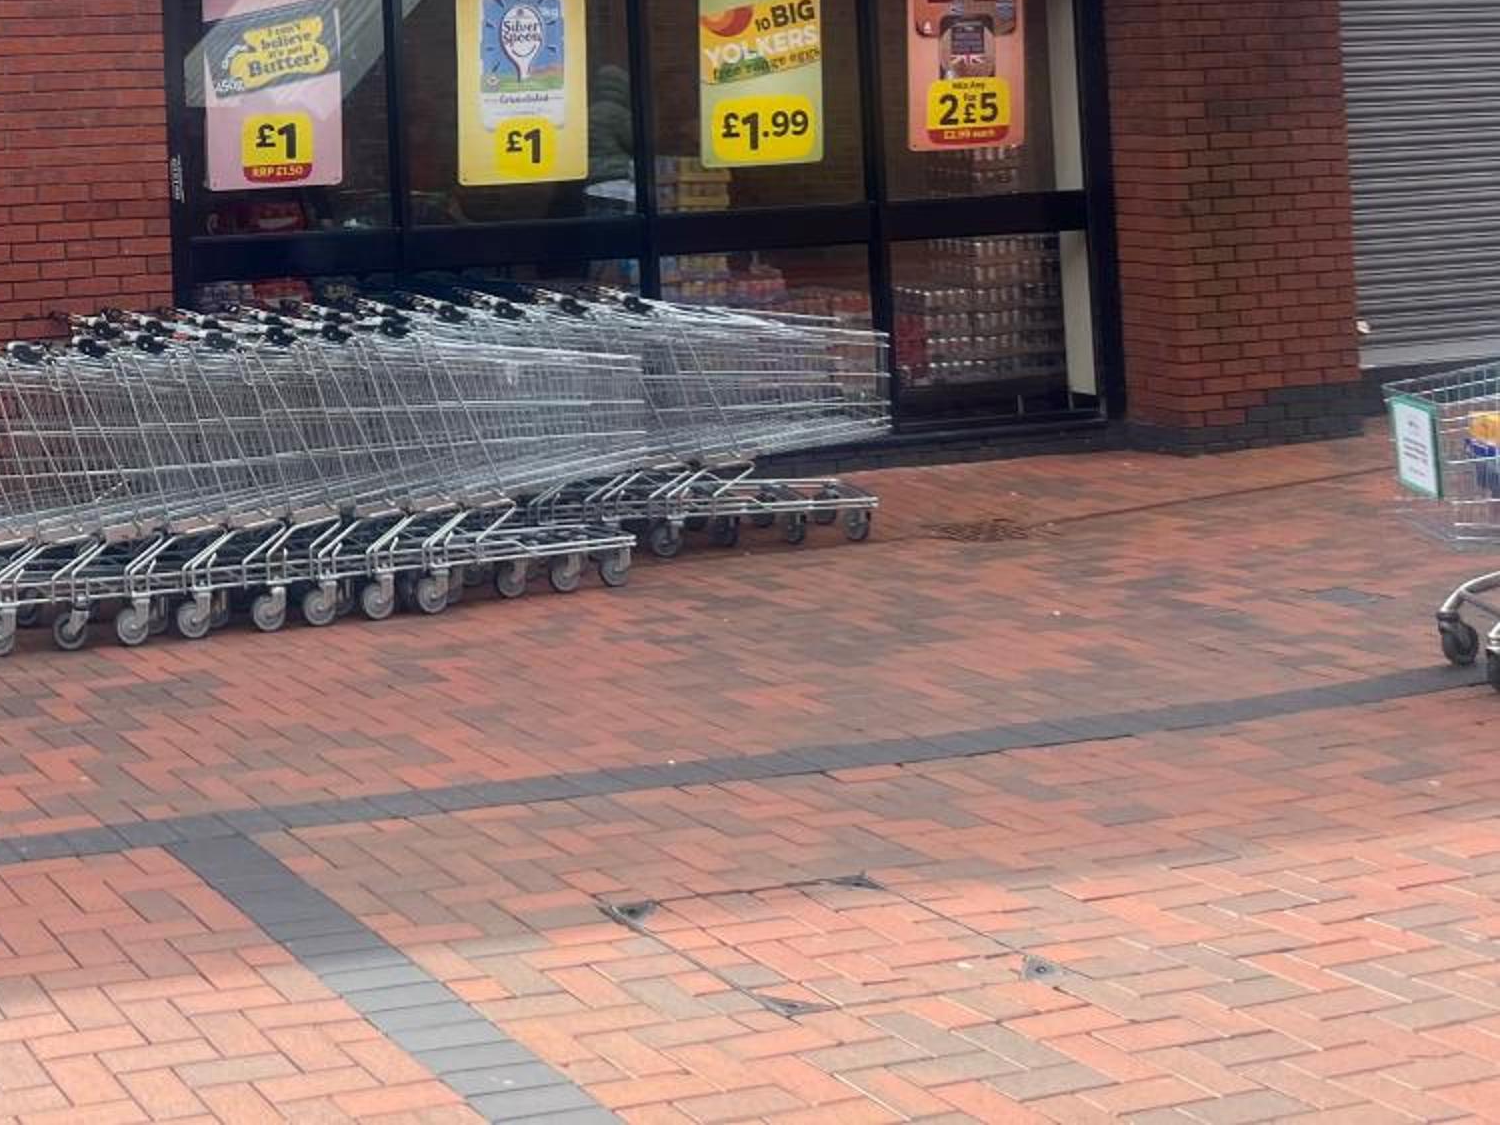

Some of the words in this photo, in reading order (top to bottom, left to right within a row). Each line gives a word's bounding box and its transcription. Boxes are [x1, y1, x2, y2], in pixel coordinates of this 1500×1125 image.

[261, 32, 311, 50] believe
[503, 20, 539, 33] Silver
[249, 46, 320, 77] Butter!
[704, 26, 820, 67] YOLKERS
[939, 93, 959, 126] 2
[256, 123, 298, 160] £1
[506, 128, 542, 164] £1
[722, 109, 809, 151] £1.99
[252, 167, 275, 177] RRP
